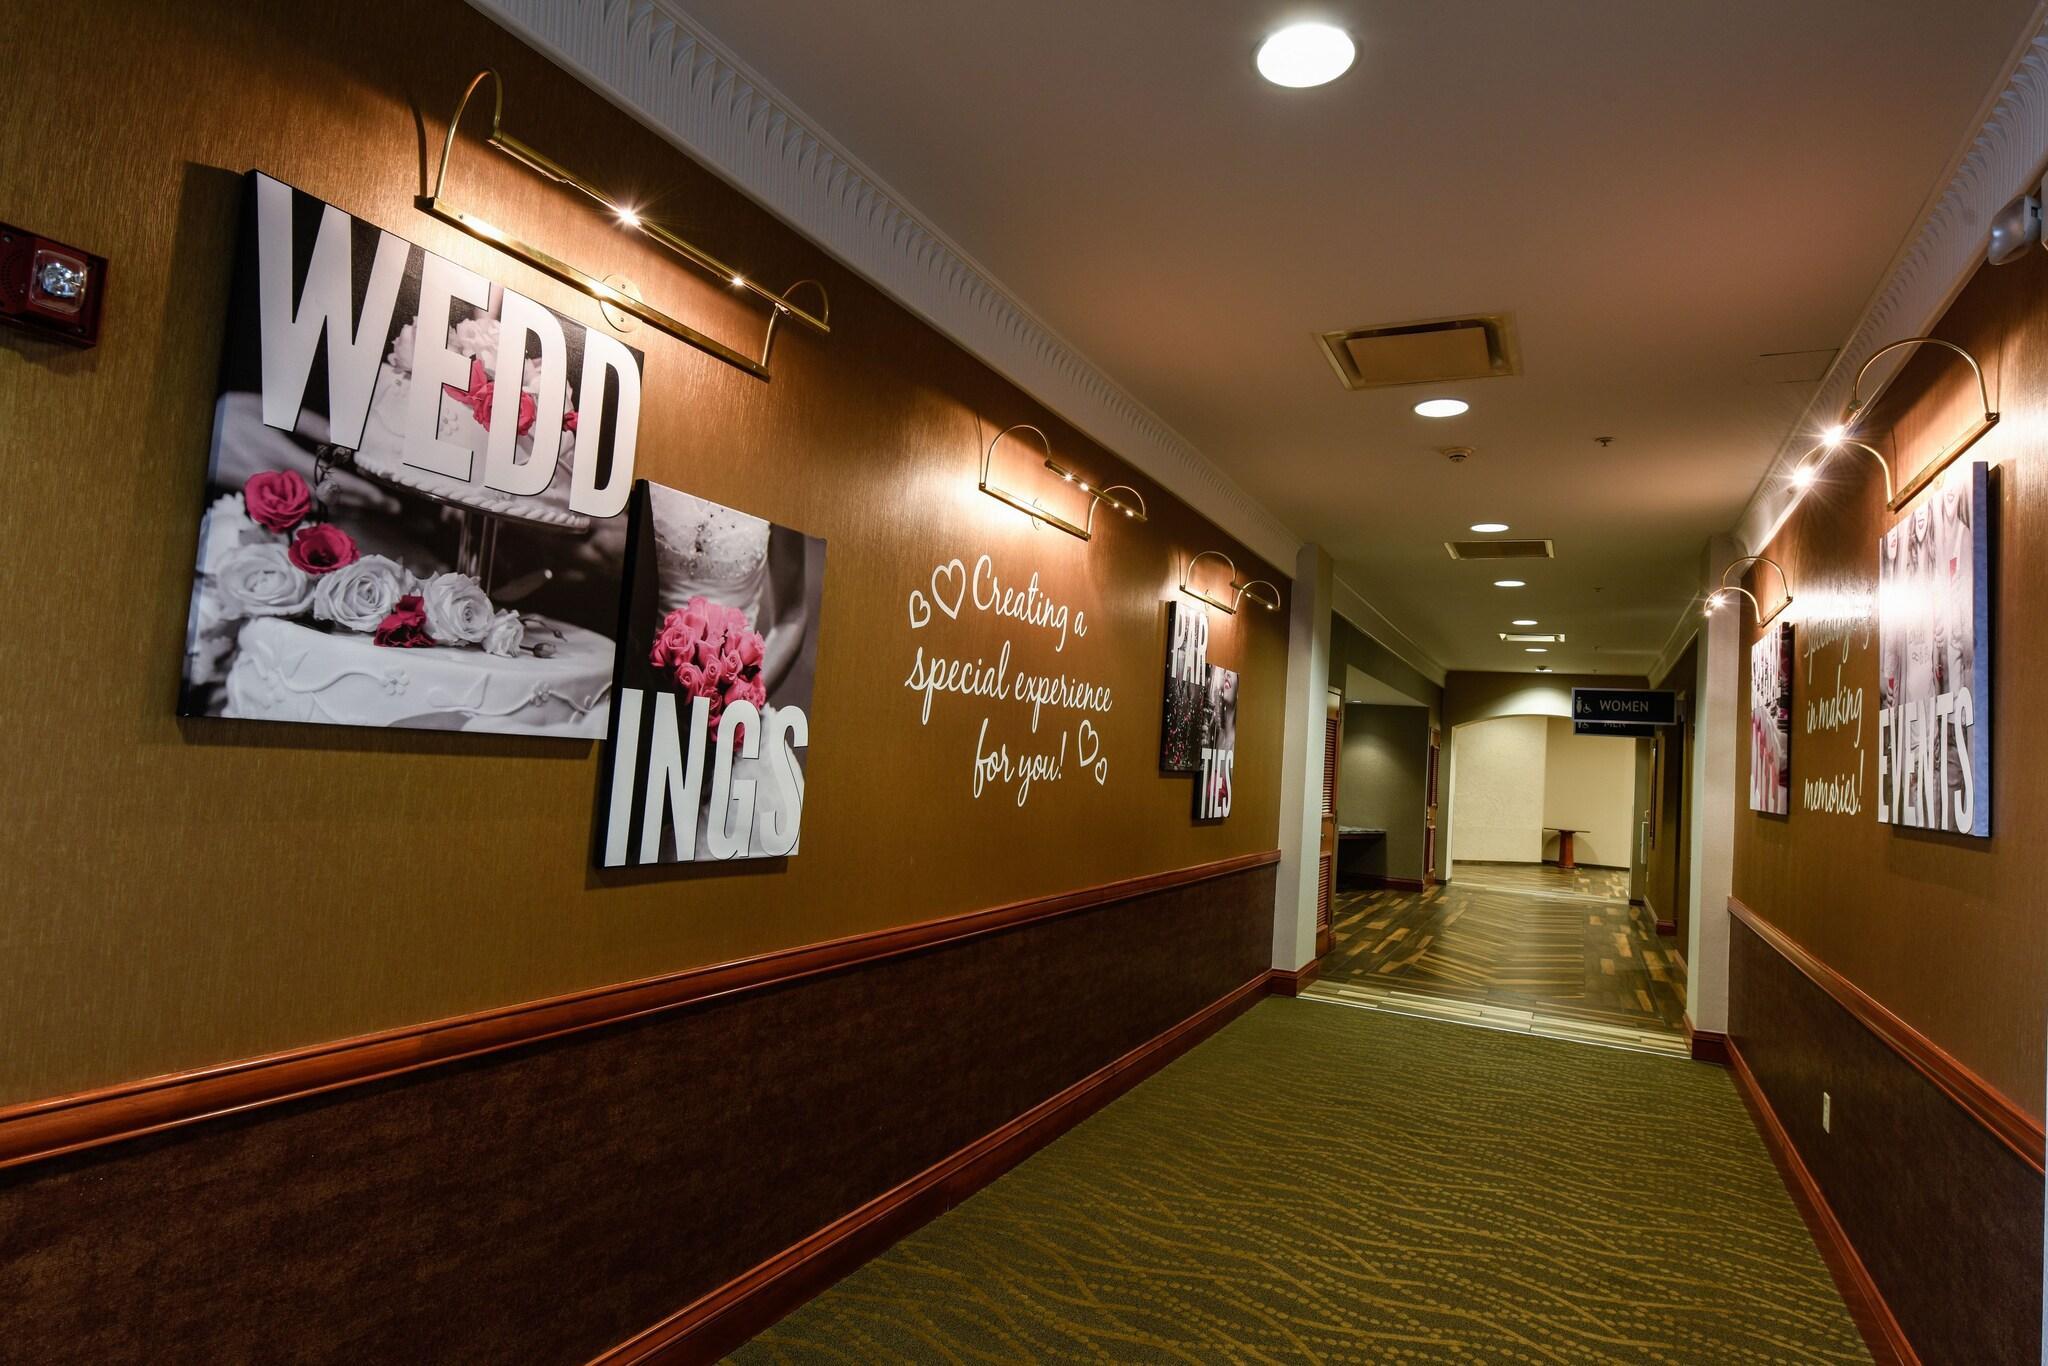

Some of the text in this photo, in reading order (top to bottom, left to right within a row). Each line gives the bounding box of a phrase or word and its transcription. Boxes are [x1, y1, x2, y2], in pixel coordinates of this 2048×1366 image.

[257, 174, 641, 518] WEDD
[972, 554, 1087, 652] Creating a
[1171, 602, 1208, 687] PAR
[905, 640, 1113, 733] special experience
[1600, 699, 1649, 713] WOMEN
[1807, 664, 1863, 748] in making
[605, 688, 809, 866] INGS
[973, 718, 1067, 807] for you!
[1200, 748, 1234, 819] TIES
[1803, 749, 1864, 816] memories!
[1878, 687, 1974, 834] EVENTS
